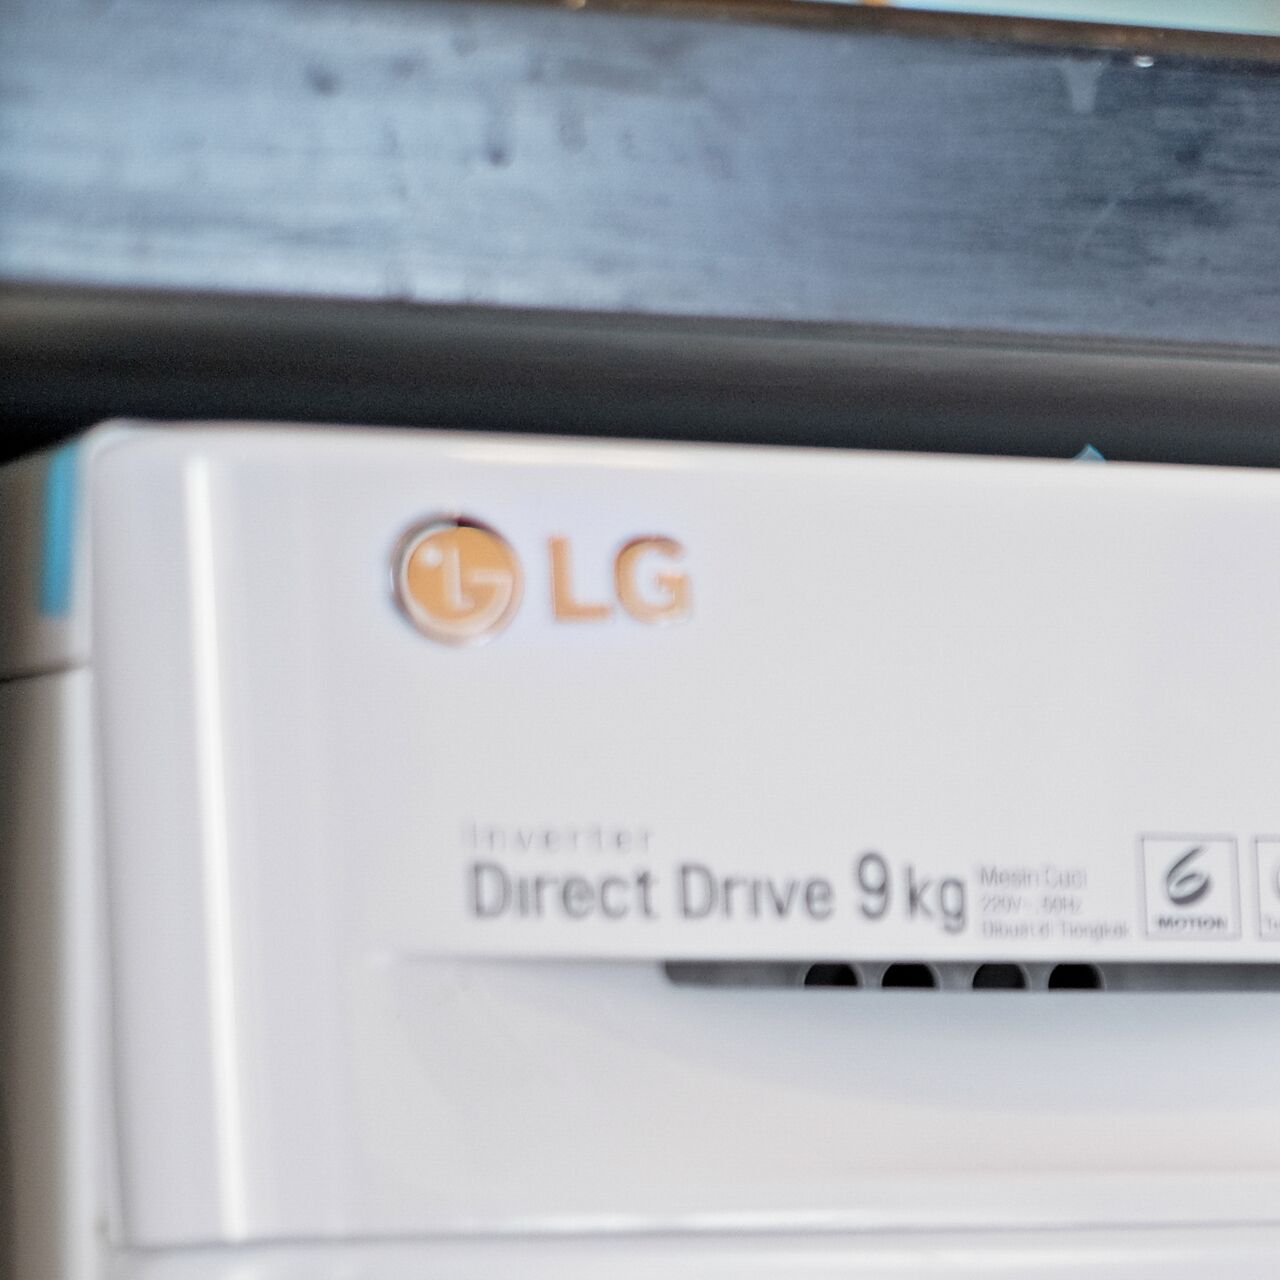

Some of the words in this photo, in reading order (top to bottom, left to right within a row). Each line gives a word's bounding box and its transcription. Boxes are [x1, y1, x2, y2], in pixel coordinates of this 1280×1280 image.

[547, 535, 691, 624] LG
[472, 823, 653, 850] Inverter
[471, 861, 657, 920] Direct
[677, 862, 836, 921] Drive
[1156, 916, 1229, 930] MOTION
